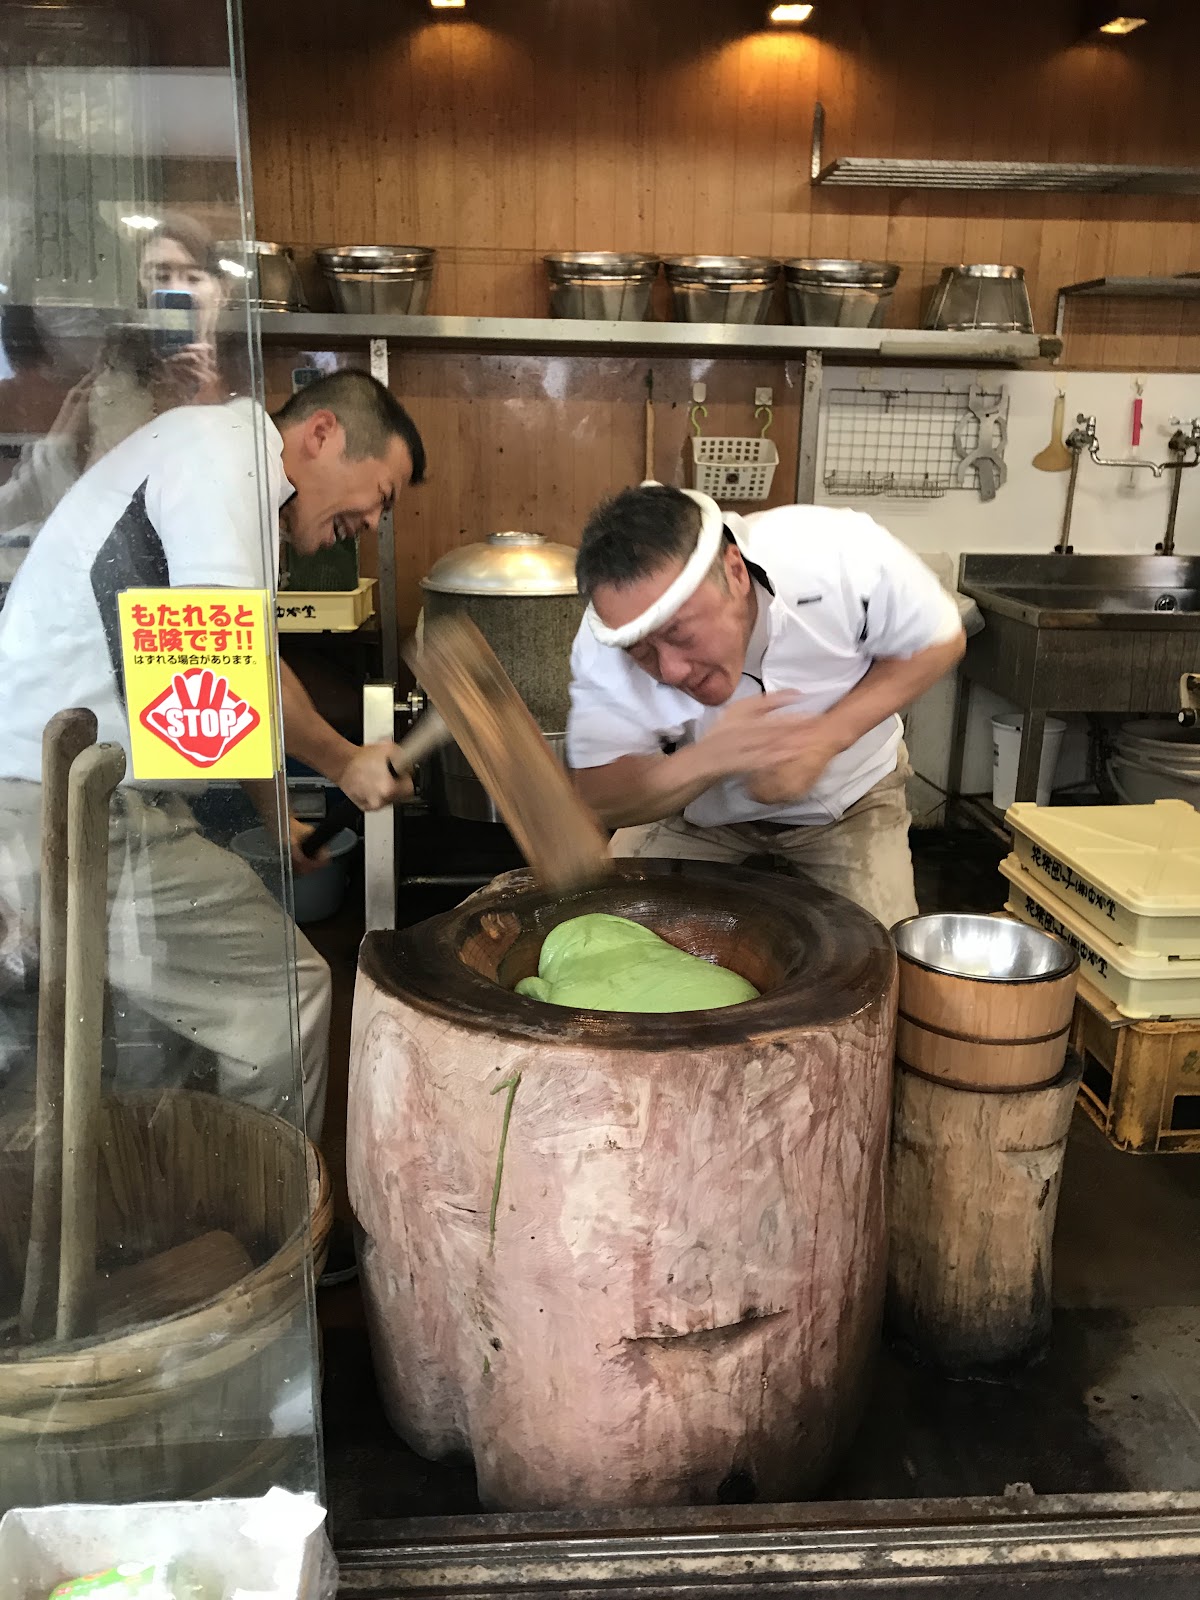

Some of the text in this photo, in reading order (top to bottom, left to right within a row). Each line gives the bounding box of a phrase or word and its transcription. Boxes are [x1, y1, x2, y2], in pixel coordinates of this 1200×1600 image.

[132, 604, 254, 627] もたれると
[132, 628, 253, 652] 危険です!!
[134, 654, 257, 665] はずれる場合があります。
[165, 708, 239, 738] STOP
